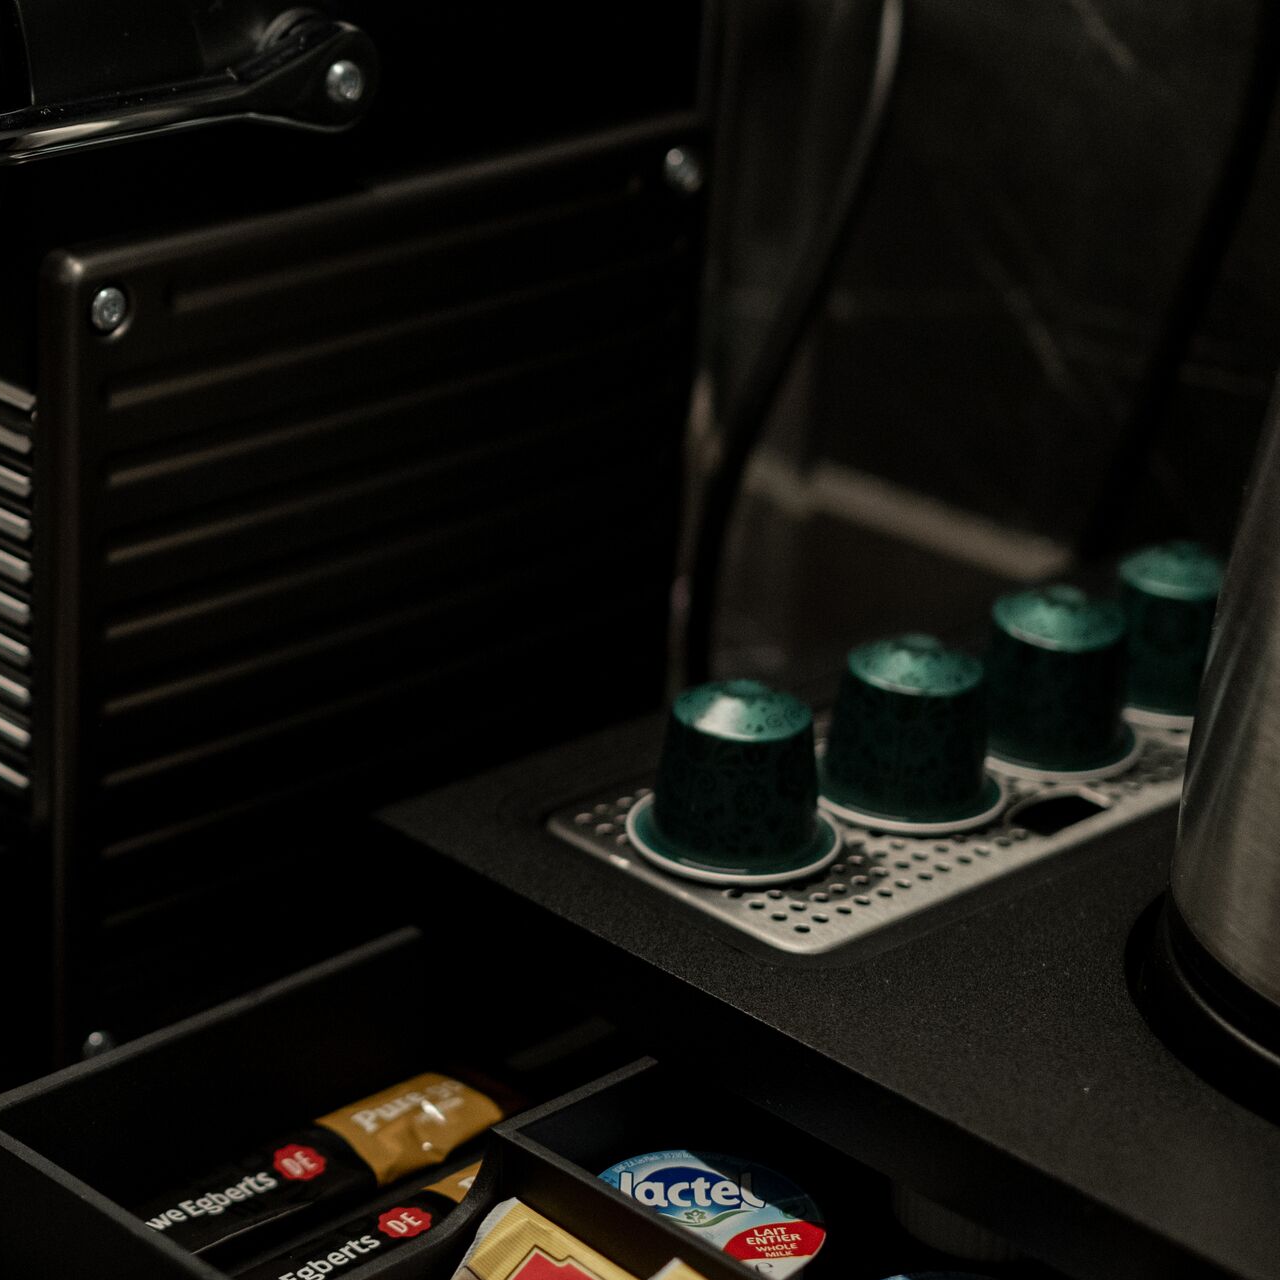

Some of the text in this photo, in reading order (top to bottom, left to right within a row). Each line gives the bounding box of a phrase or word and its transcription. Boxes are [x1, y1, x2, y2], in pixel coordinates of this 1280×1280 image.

[618, 1170, 767, 1209] lactel
[145, 1170, 278, 1231] we Egberts
[753, 1227, 787, 1237] LAIT
[746, 1232, 802, 1246] ENTIER
[755, 1242, 799, 1253] WHOLE
[765, 1250, 795, 1259] MILK
